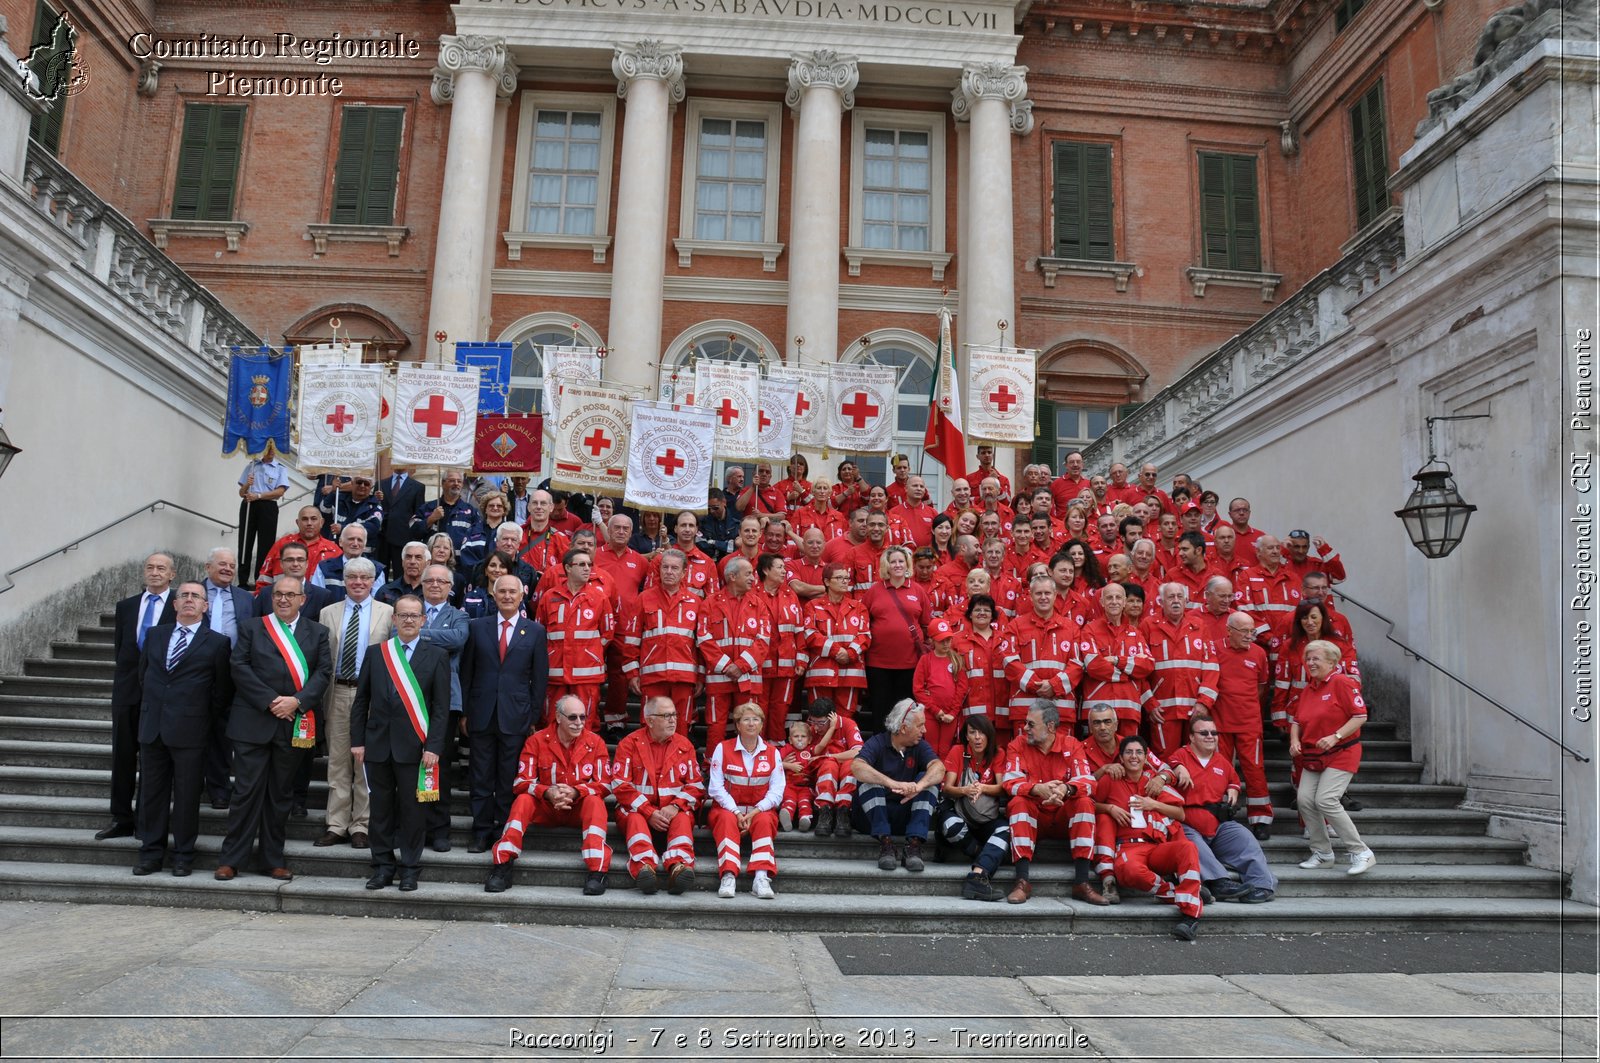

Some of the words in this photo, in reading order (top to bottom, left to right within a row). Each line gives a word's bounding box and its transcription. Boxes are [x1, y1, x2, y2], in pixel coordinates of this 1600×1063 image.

[693, 0, 844, 20] SABAVDIA
[857, 4, 997, 30] MDCCLVII
[567, 388, 582, 396] CORPO
[583, 390, 607, 399] VOLONTARI
[559, 408, 582, 430] CROCE
[582, 403, 611, 413] ROSSA
[636, 413, 652, 421] CORPO
[653, 416, 678, 425] VOLONTARI
[591, 417, 617, 432] GINEVRA
[497, 422, 537, 444] COMUNALE
[633, 429, 654, 454] CROCE
[653, 424, 683, 435] ROSSA
[683, 429, 710, 463] ITALIANA
[662, 436, 690, 450] GINEVRA
[405, 445, 453, 455] DELEGAZIONE
[406, 452, 458, 462] PEVERAGNO
[555, 470, 590, 482] COMITATO
[631, 489, 657, 499] GRUPPO
